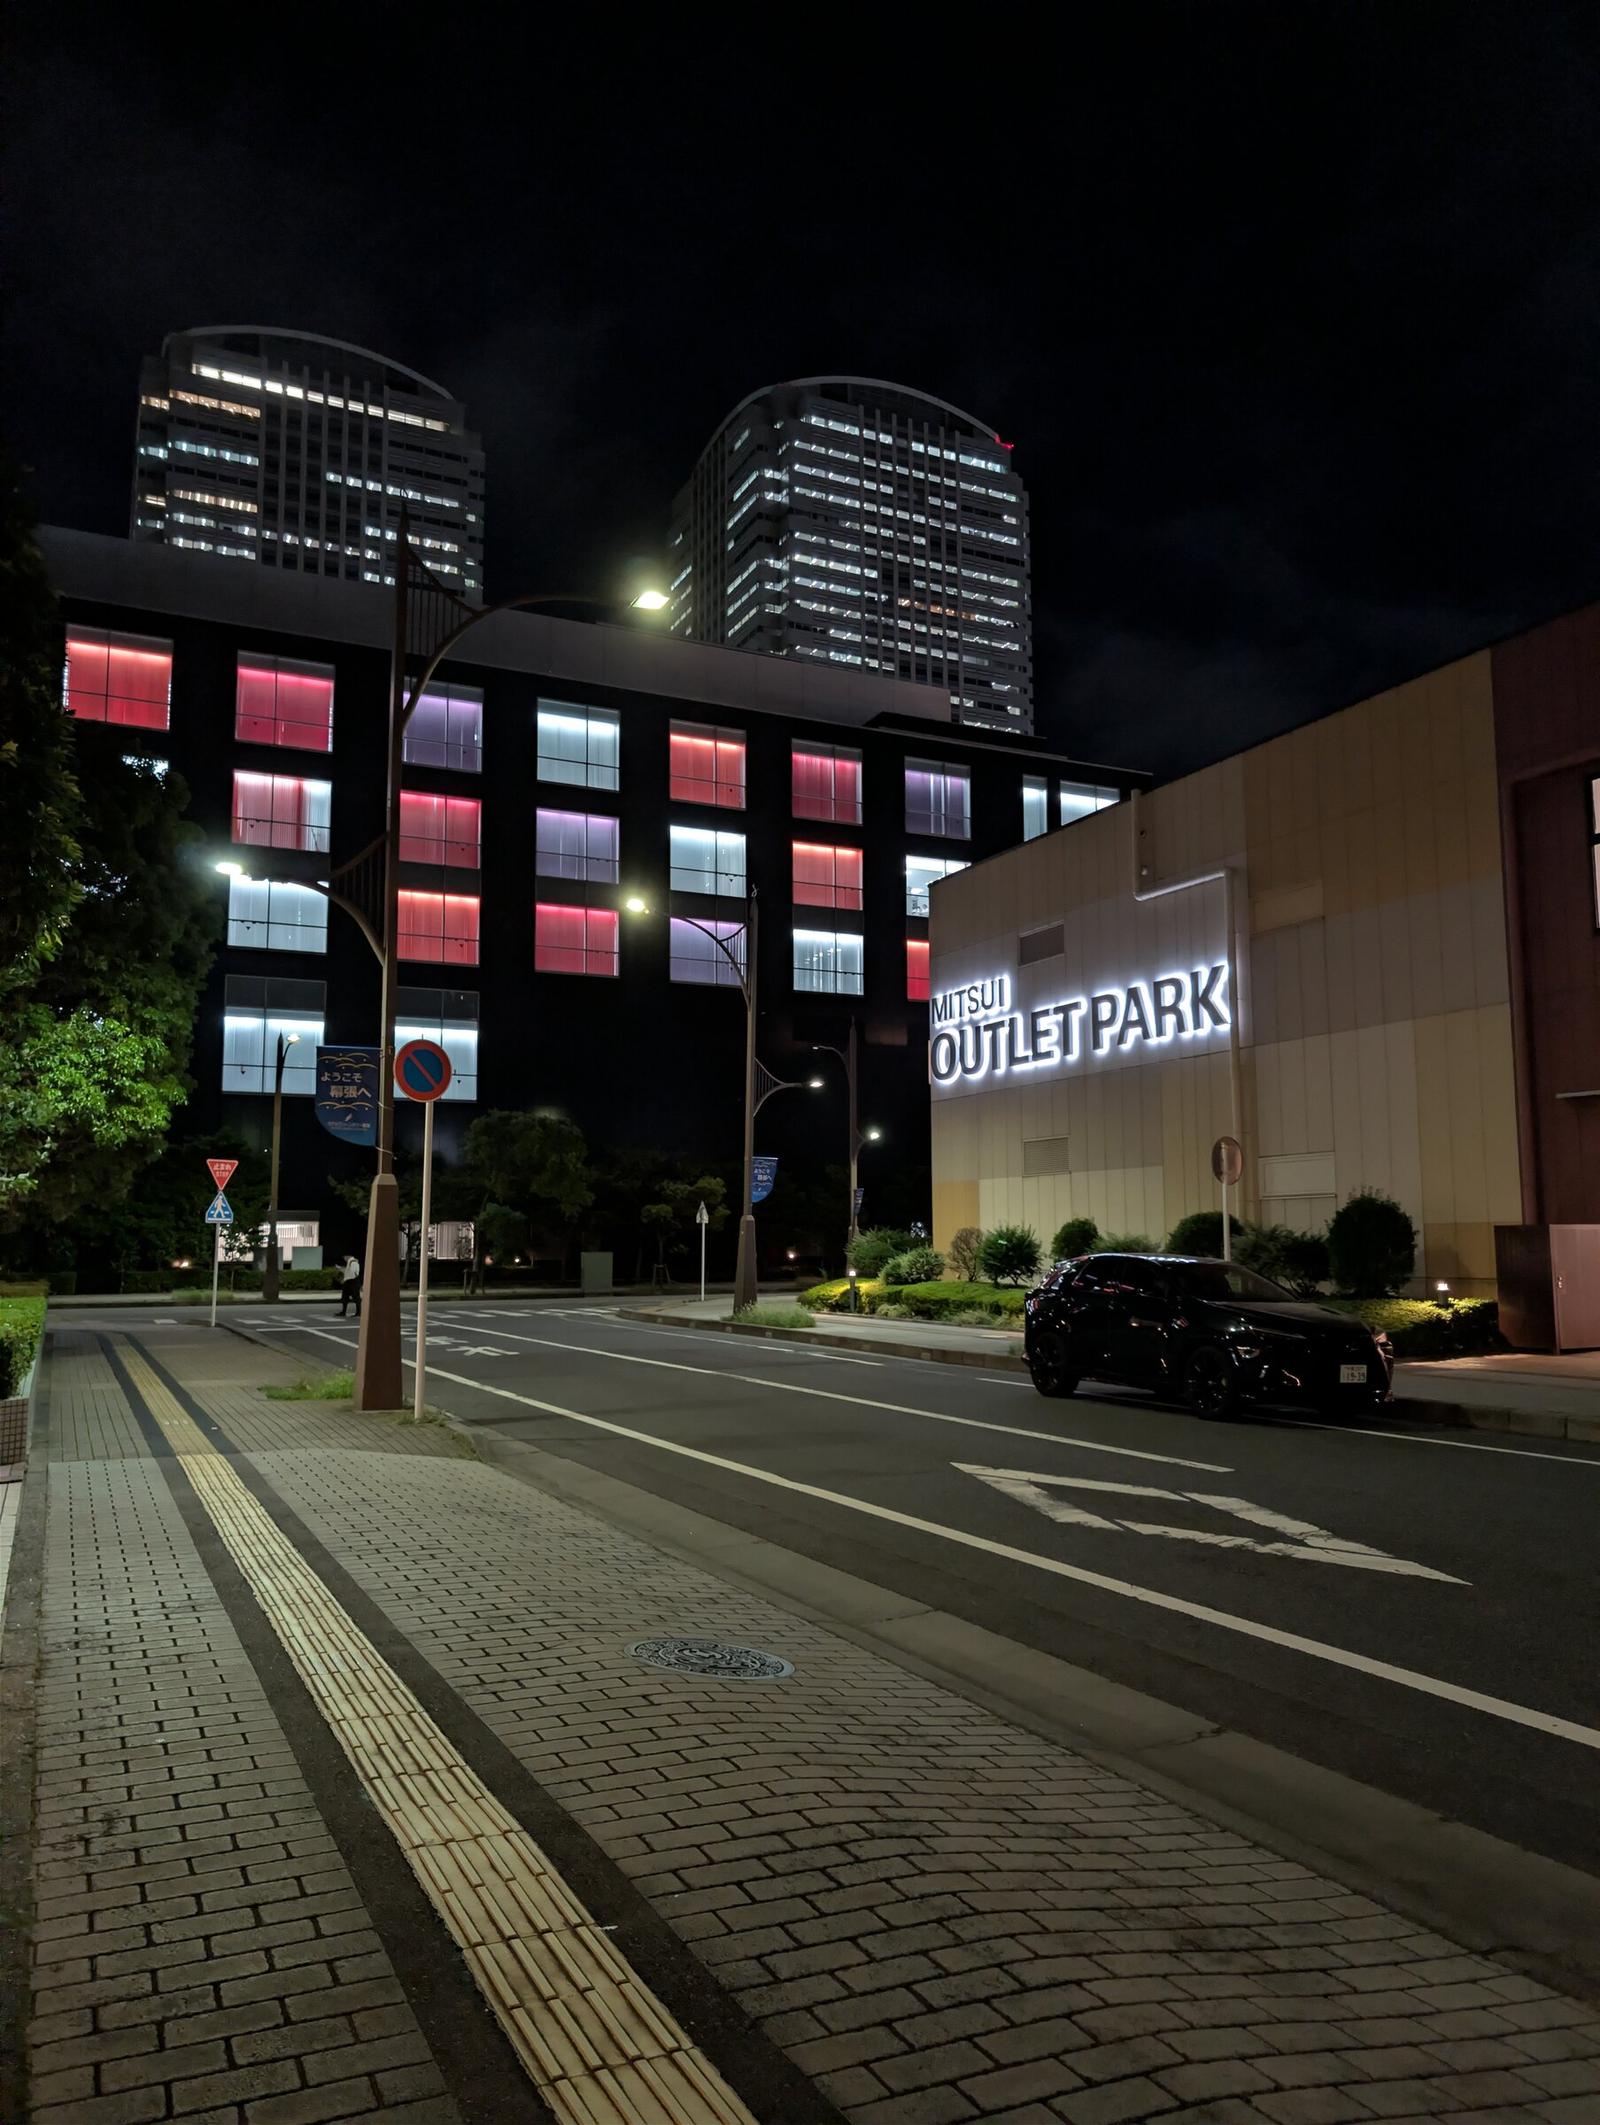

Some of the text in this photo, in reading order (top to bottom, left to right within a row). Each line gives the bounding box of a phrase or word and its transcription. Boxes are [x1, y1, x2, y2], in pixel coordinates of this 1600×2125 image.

[931, 975, 1006, 1025] MITSUI
[931, 964, 1231, 1081] OUTLET PARK
[321, 1072, 362, 1082] ようこそ
[330, 1085, 372, 1098] 幕張へ
